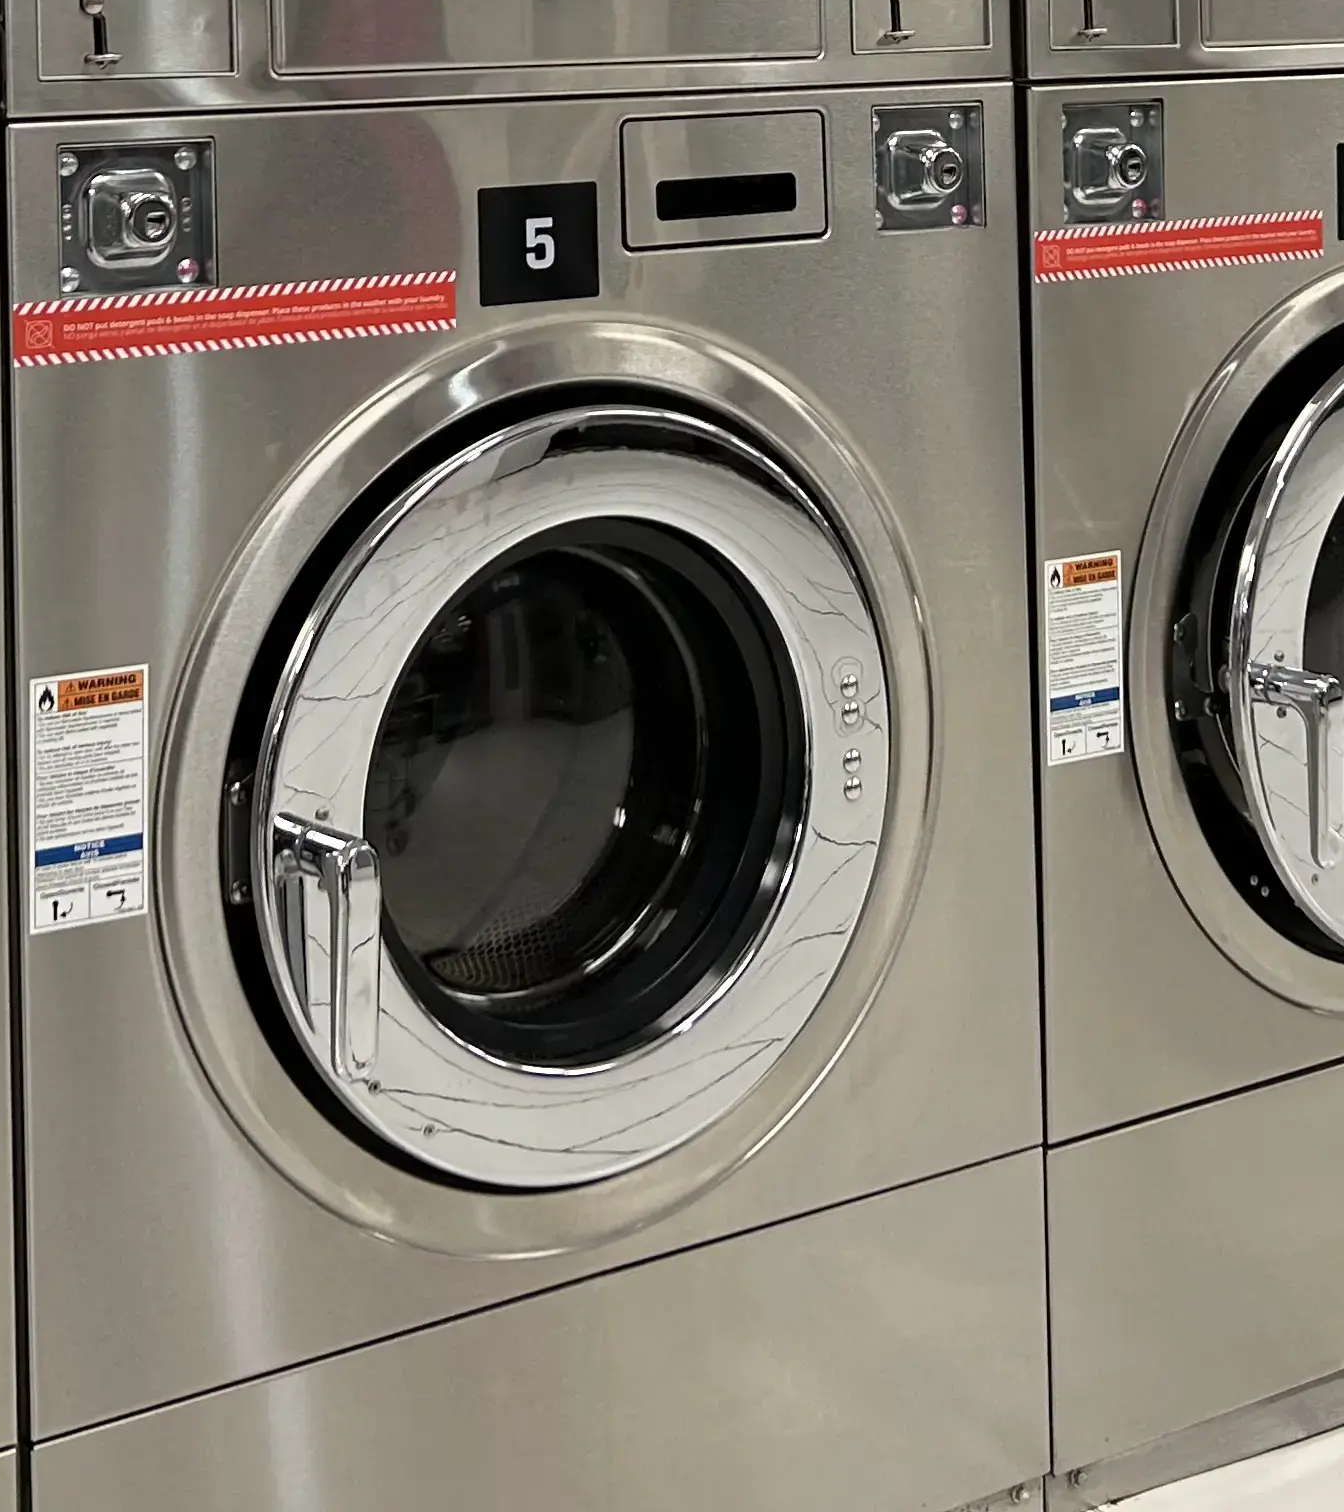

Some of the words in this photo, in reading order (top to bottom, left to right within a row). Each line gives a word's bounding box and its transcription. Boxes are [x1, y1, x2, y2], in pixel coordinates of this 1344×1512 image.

[525, 217, 556, 271] 5
[63, 323, 76, 332] DO
[77, 322, 94, 331] NOT
[78, 674, 136, 690] WARNING
[98, 693, 110, 703] EN
